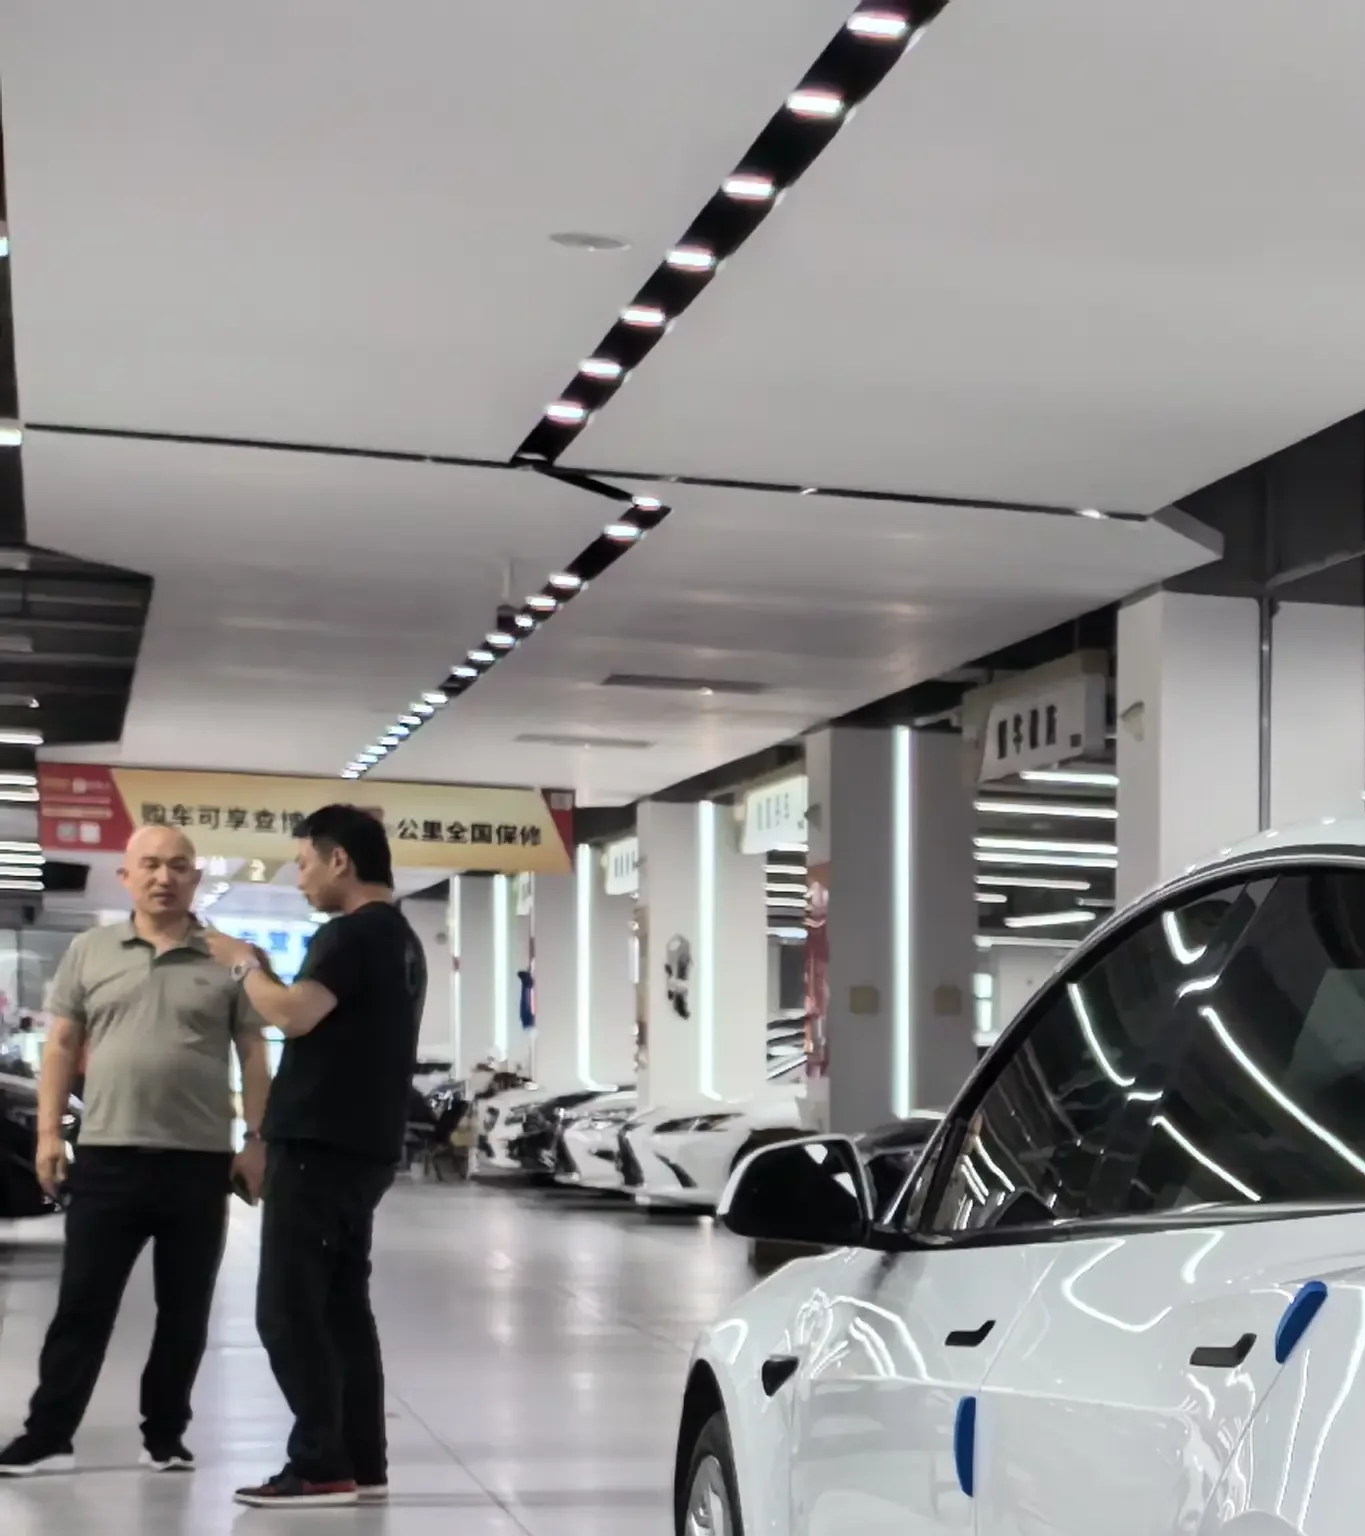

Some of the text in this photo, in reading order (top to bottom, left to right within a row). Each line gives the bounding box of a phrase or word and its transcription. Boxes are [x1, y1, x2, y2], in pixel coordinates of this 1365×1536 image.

[397, 818, 542, 847] 公里全国保修
